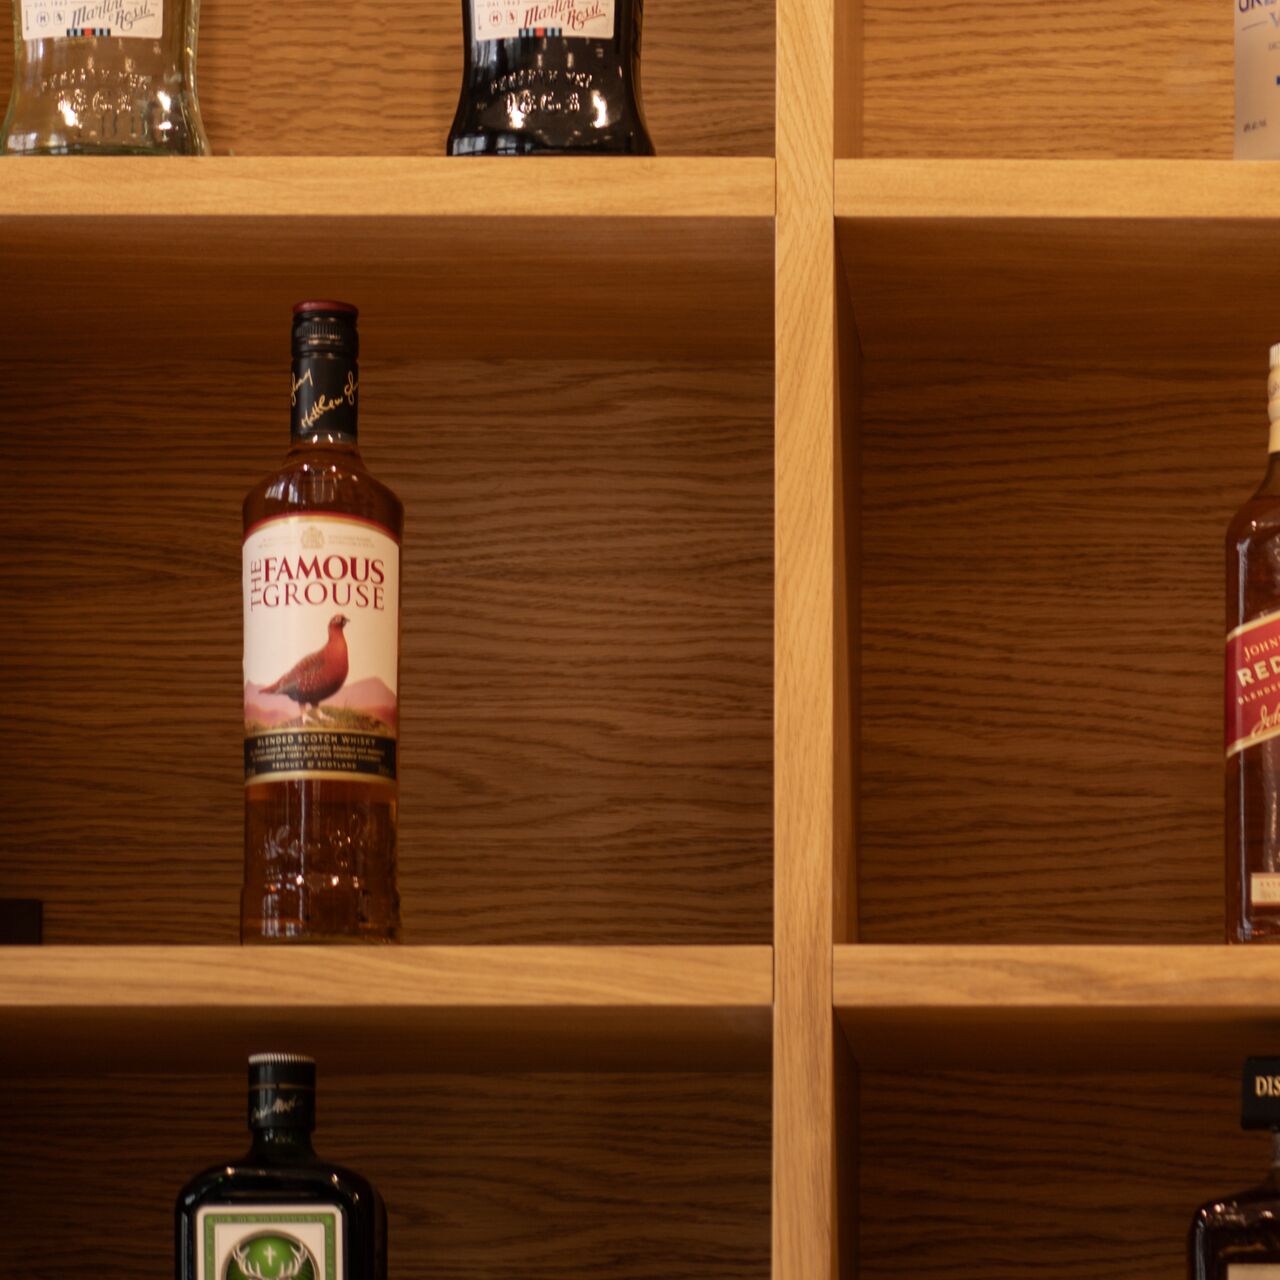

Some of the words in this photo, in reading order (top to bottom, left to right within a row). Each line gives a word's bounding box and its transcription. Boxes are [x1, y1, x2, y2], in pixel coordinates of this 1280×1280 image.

[264, 554, 385, 585] FAMOUS
[250, 559, 262, 612] THE
[262, 581, 385, 611] GROUSE
[257, 734, 294, 747] BLENDED
[298, 734, 338, 745] SCOTCH
